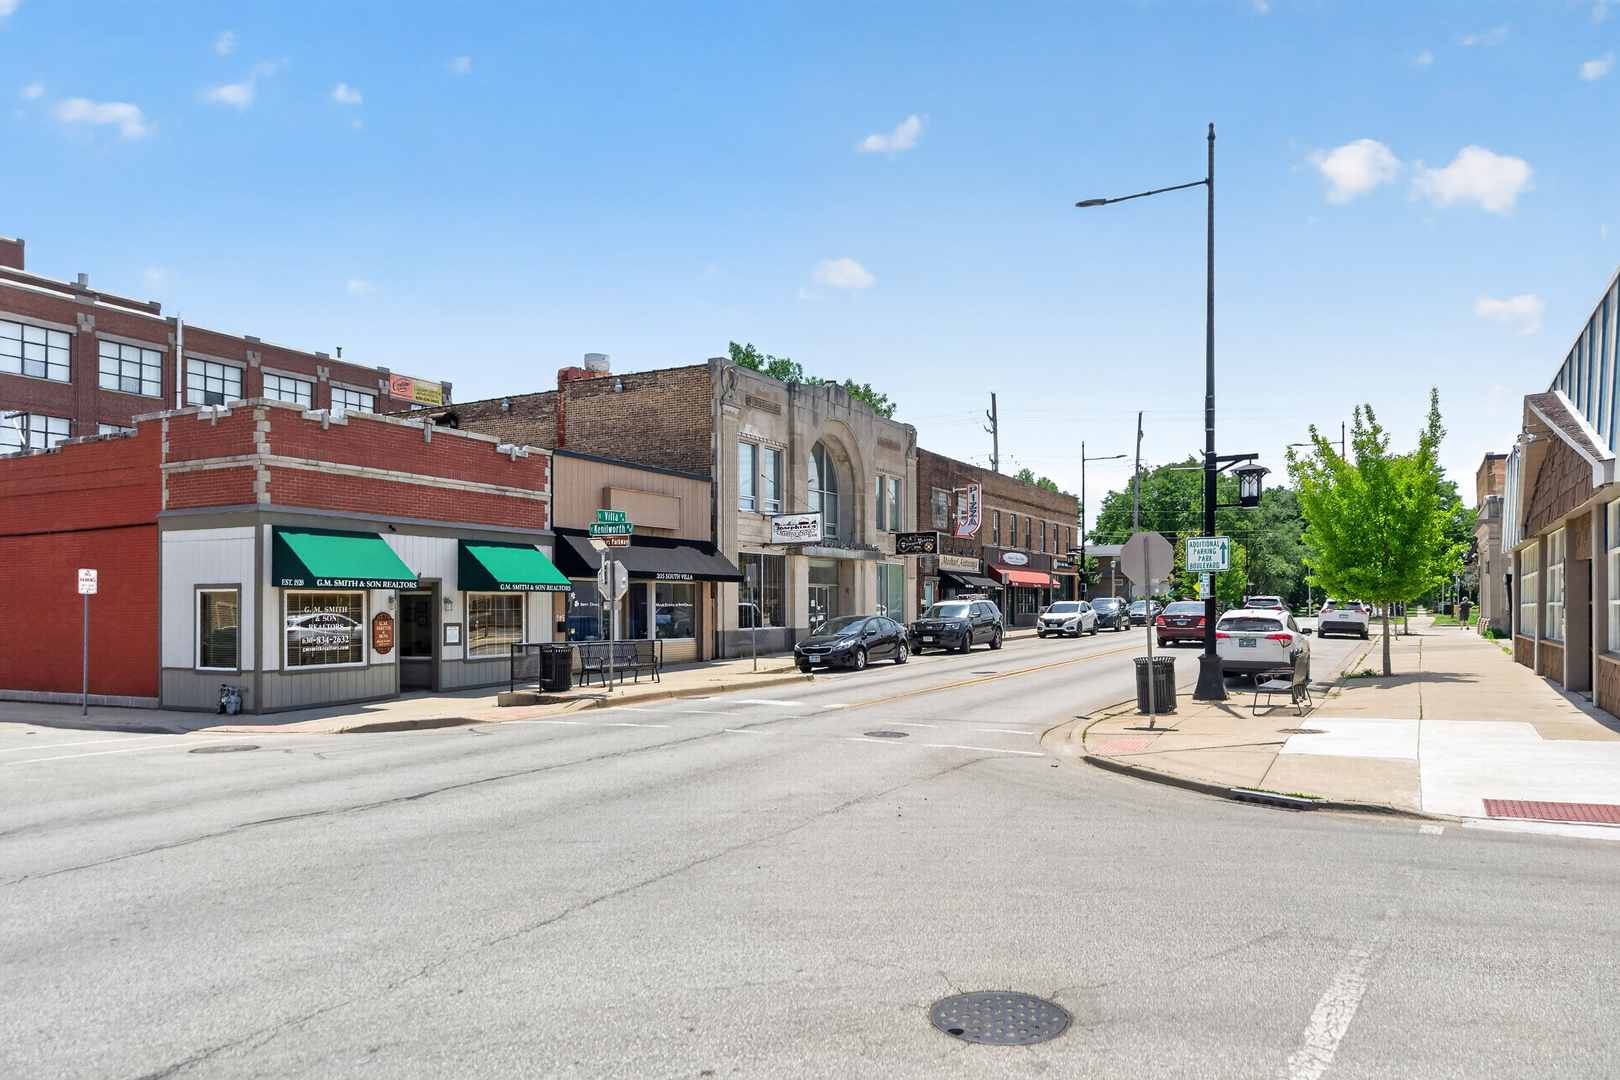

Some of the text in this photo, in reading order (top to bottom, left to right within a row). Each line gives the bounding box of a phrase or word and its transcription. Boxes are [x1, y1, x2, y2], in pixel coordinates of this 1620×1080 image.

[968, 486, 978, 526] PIZZA
[604, 512, 619, 521] Villa
[594, 524, 626, 534] Kenilworth
[302, 636, 349, 644] 630-834-2632
